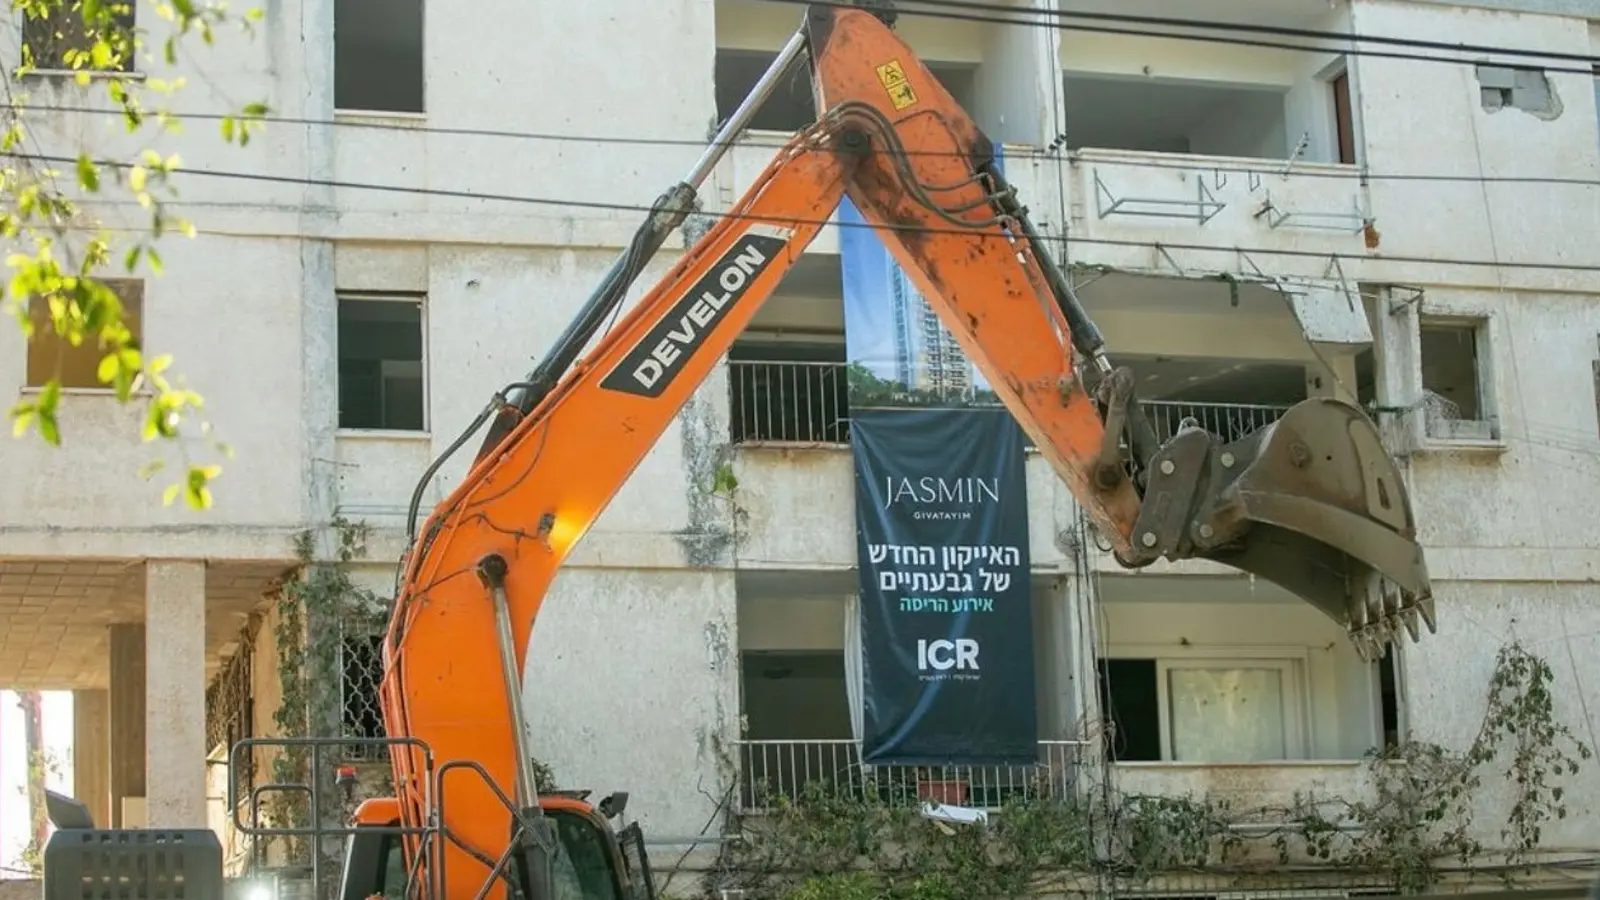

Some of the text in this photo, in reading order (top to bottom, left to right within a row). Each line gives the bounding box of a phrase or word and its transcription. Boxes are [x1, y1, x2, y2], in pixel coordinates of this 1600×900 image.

[632, 244, 766, 389] DEVELON
[884, 476, 1000, 510] JASMIN
[913, 511, 972, 520] GIVATAYIM
[868, 543, 1021, 571] האייקון החדש
[879, 568, 1011, 592] של גבעתיים
[899, 597, 994, 613] אירוע הריסה
[917, 638, 980, 670] ICR
